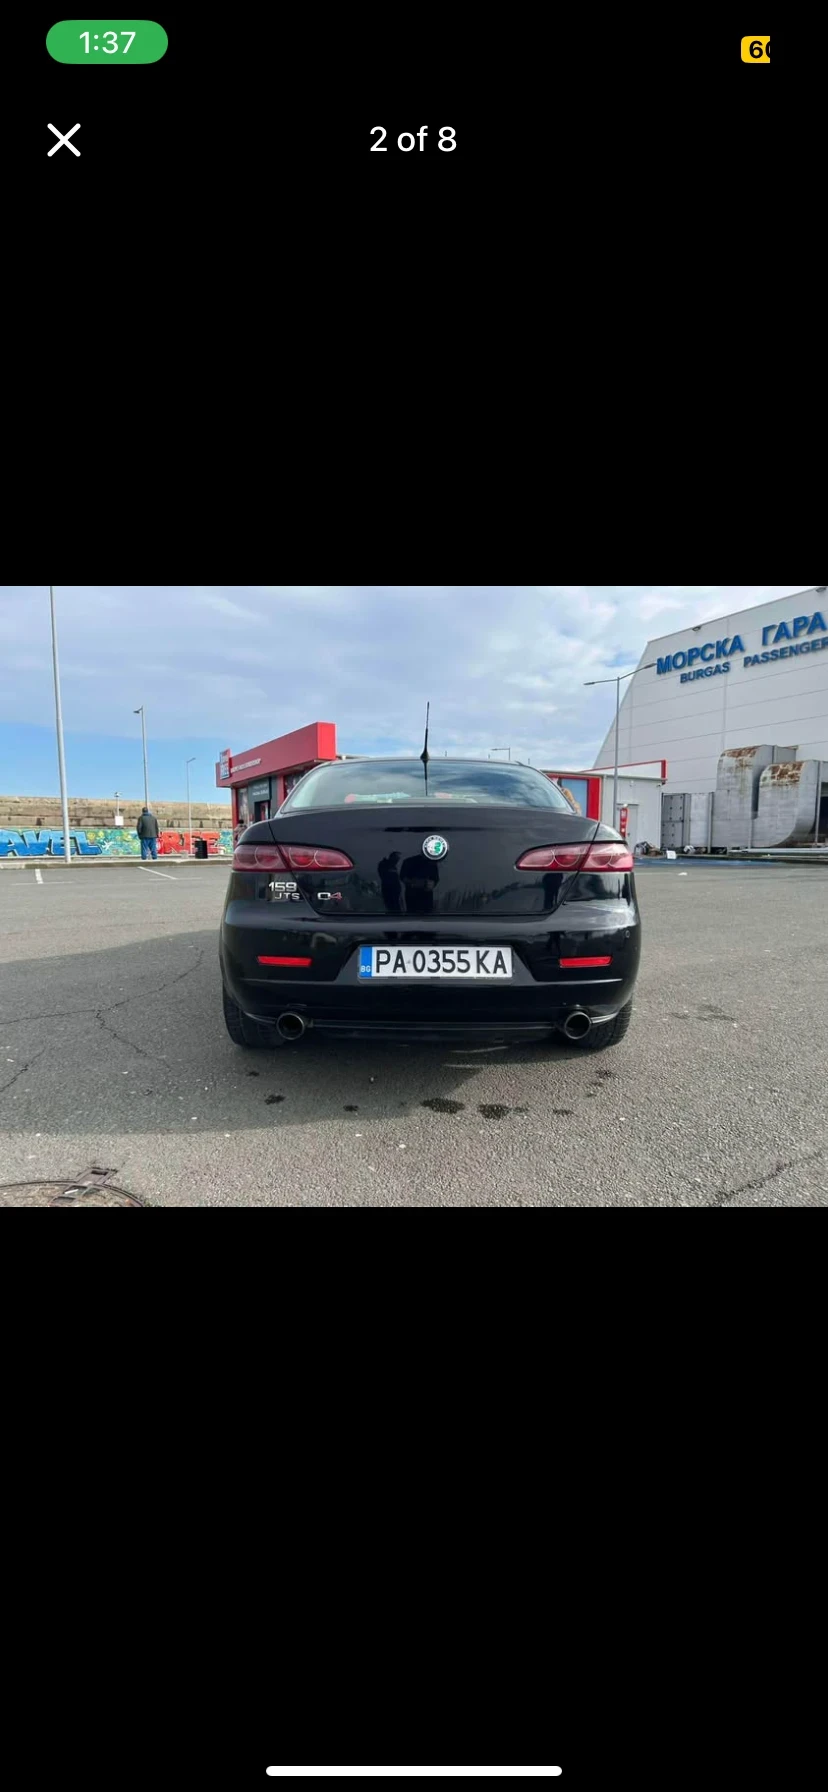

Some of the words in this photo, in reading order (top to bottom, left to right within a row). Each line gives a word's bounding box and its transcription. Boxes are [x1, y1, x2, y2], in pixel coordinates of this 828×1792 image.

[656, 634, 745, 675] МОРСКА
[761, 611, 828, 646] ГАРА
[679, 661, 731, 684] BURGAS
[743, 637, 828, 668] PASSENGER
[268, 881, 298, 892] 159
[274, 892, 300, 900] JTS
